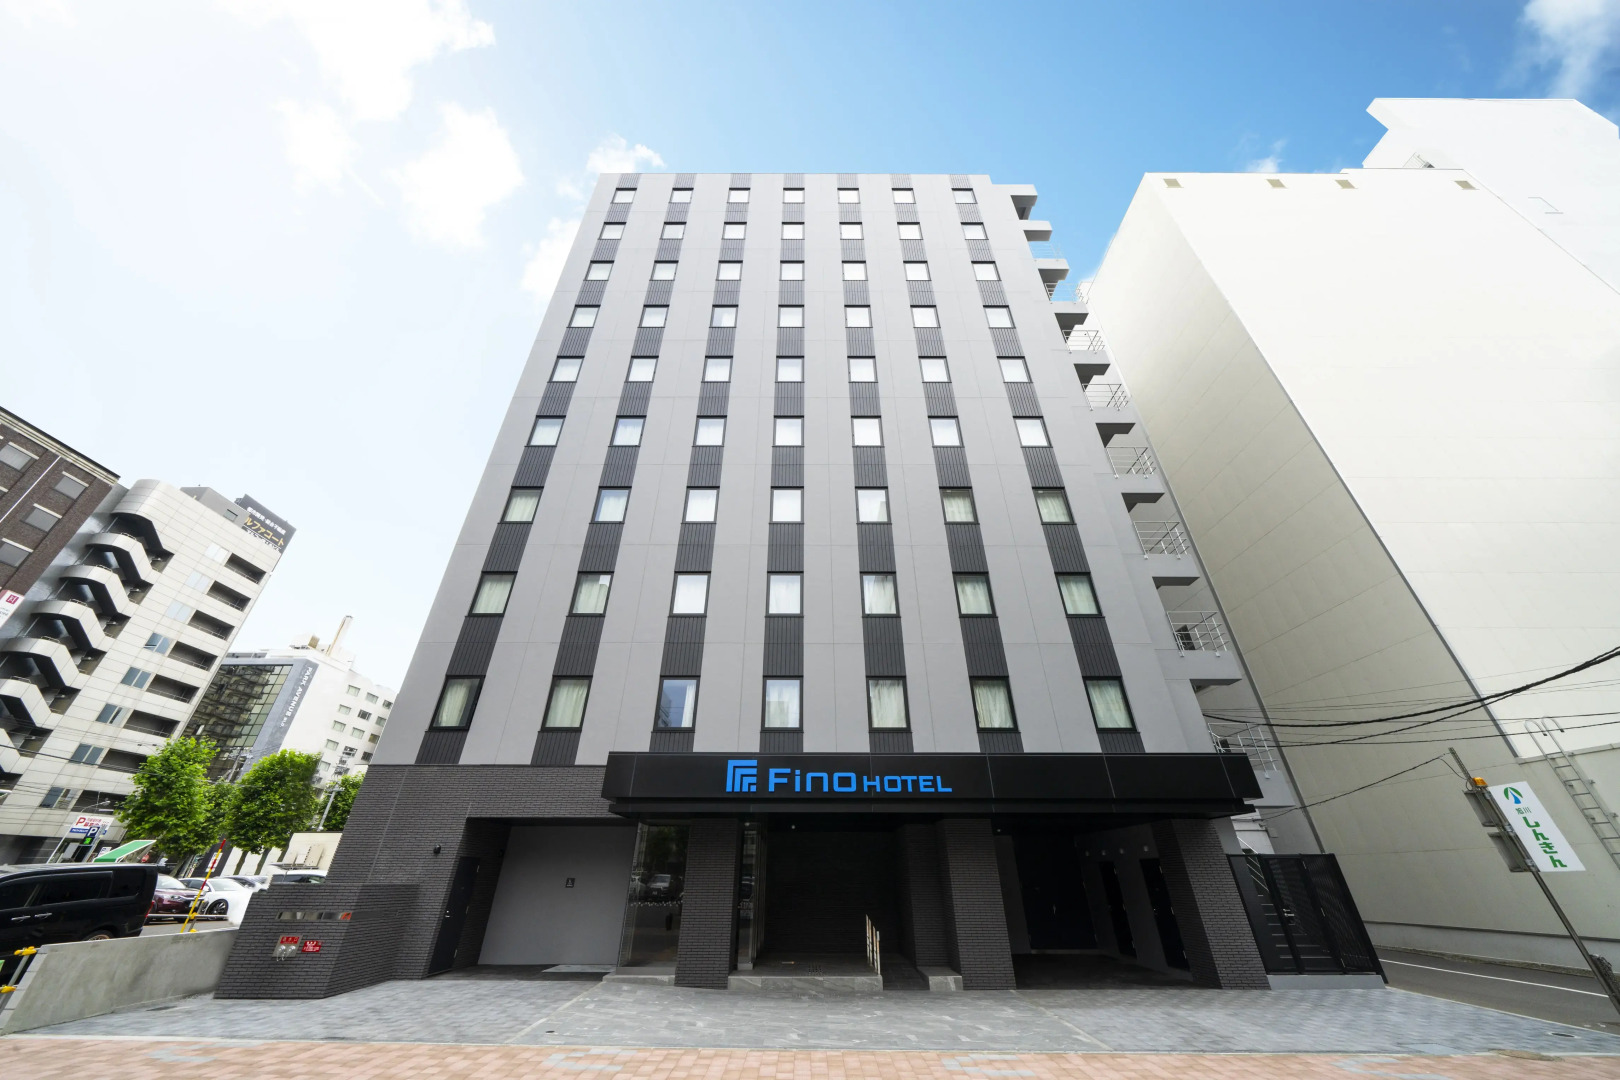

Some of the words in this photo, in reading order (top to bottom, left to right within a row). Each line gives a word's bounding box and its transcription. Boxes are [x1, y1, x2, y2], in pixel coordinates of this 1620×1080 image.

[245, 517, 284, 546] ルファコート
[301, 667, 313, 686] PARK
[286, 686, 303, 717] AVENUE
[768, 768, 857, 792] Fino
[862, 775, 953, 793] HOTEL
[76, 816, 86, 826] P
[1515, 806, 1532, 815] 旭川
[87, 827, 98, 836] P
[1522, 816, 1568, 868] しんきん
